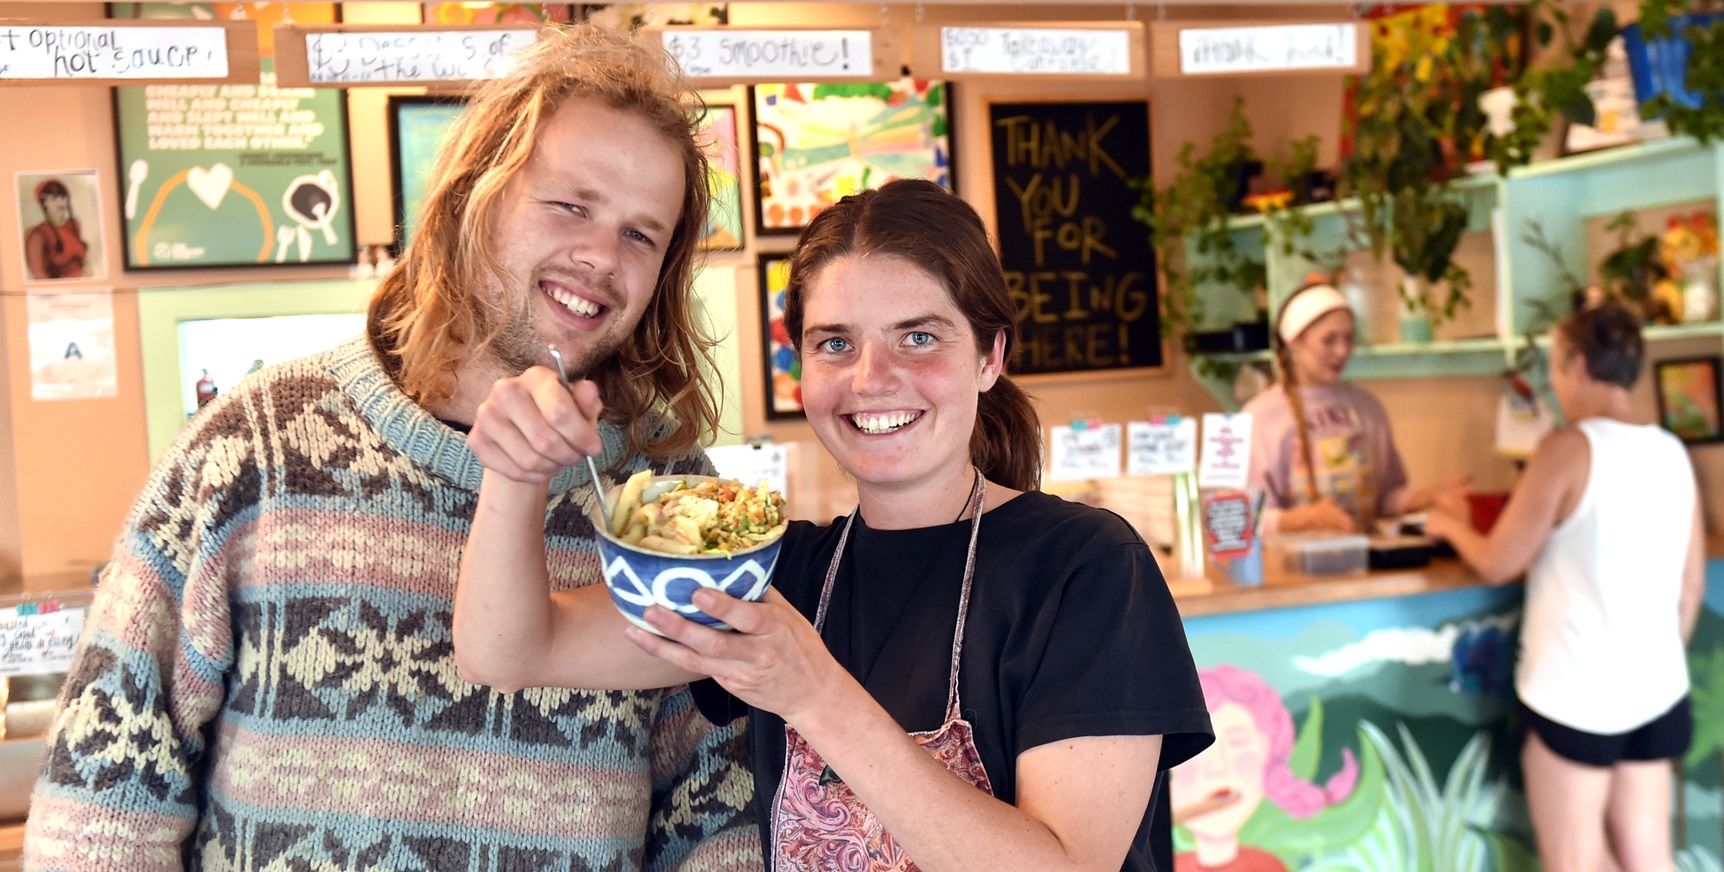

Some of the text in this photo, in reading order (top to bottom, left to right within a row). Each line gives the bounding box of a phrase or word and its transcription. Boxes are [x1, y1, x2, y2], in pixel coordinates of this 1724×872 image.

[54, 45, 99, 77] hot
[373, 58, 421, 79] the
[219, 85, 256, 98] AND
[146, 98, 187, 111] WELL
[191, 97, 227, 110] AND
[148, 110, 184, 124] AND
[235, 110, 277, 124] WELL
[279, 110, 316, 123] AND
[202, 123, 286, 137] TOGETHER
[288, 123, 325, 136] AND
[149, 137, 202, 150] LOVED
[204, 137, 248, 150] EACH
[997, 113, 1128, 179] THANK
[1005, 173, 1080, 234] YOU
[1034, 216, 1119, 267] FOR
[1004, 271, 1147, 323] BEING
[64, 341, 83, 360] A
[1018, 324, 1131, 366] HERE!
